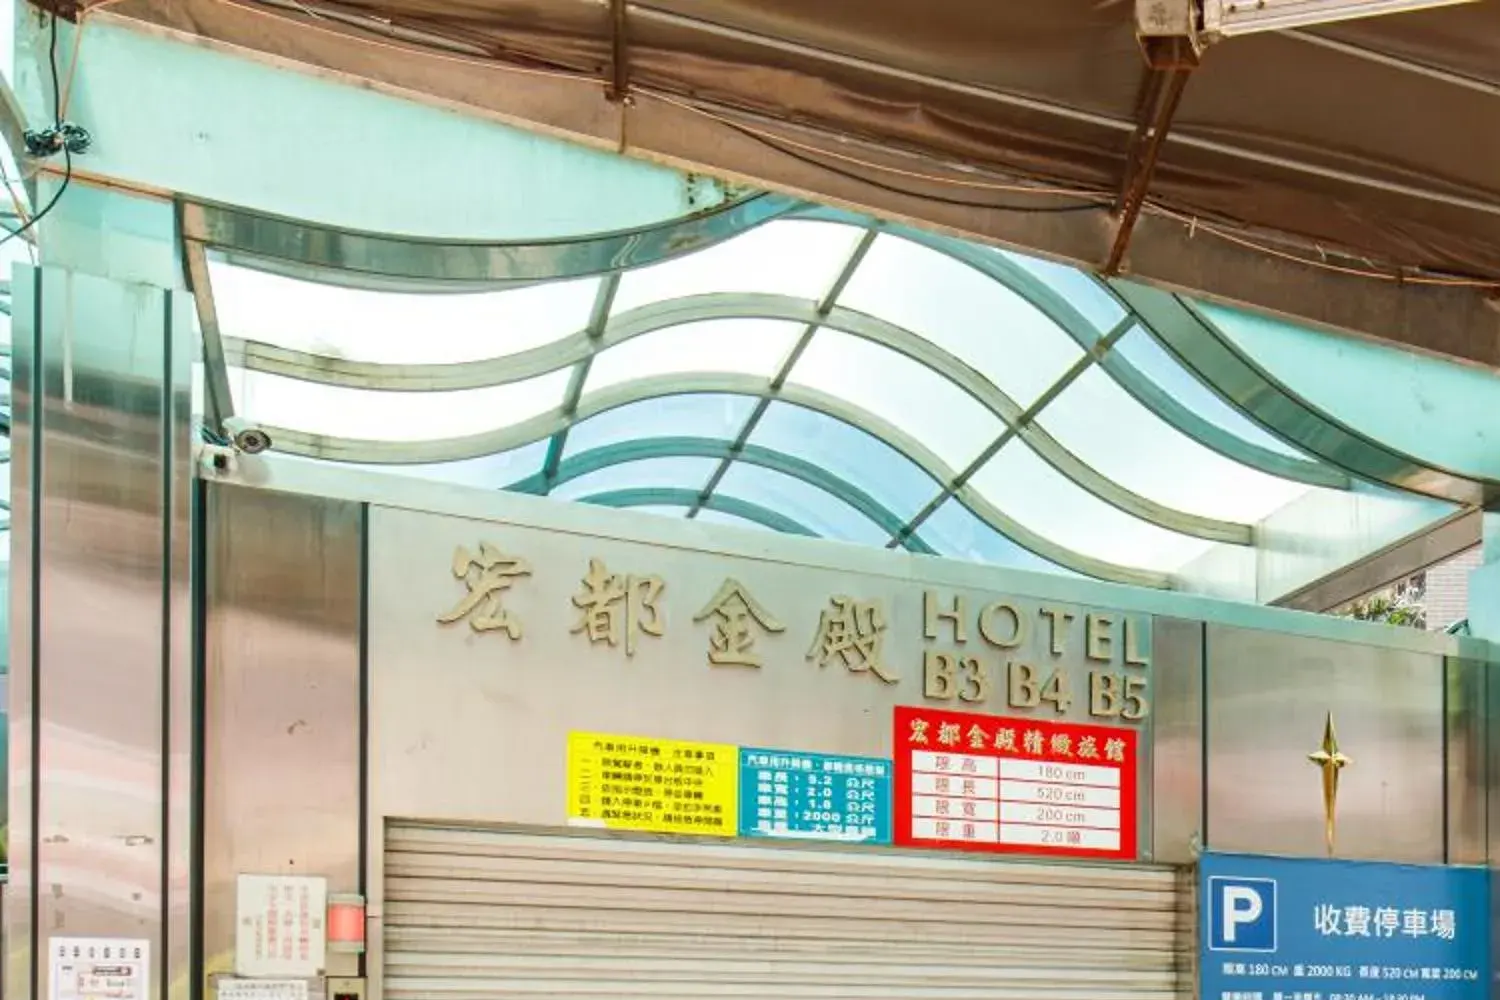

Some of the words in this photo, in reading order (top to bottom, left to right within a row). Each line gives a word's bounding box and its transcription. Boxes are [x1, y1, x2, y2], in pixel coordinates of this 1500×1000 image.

[436, 541, 899, 684] 宏都金殿
[923, 588, 1148, 666] HOTEL
[923, 651, 990, 702] B3
[1007, 660, 1072, 714] B4
[1089, 671, 1148, 722] B5
[908, 717, 1128, 762] 宏都金殿精緻旅館
[935, 755, 977, 773] 限高
[1037, 765, 1063, 780] 180
[1065, 767, 1086, 781] cm
[806, 787, 833, 798] 2.0
[1036, 786, 1063, 801] 520
[1065, 789, 1086, 801] cm
[1036, 807, 1063, 822] 200
[1065, 810, 1086, 823] cm
[1041, 830, 1063, 844] 2.0
[1222, 885, 1263, 943] P
[1314, 903, 1456, 939] 收費停車場
[1248, 963, 1270, 976] 180
[1307, 965, 1334, 977] 2000
[1335, 965, 1352, 977] KG
[1382, 967, 1401, 979] 520
[1403, 967, 1419, 979] CM
[1463, 969, 1479, 979] CM
